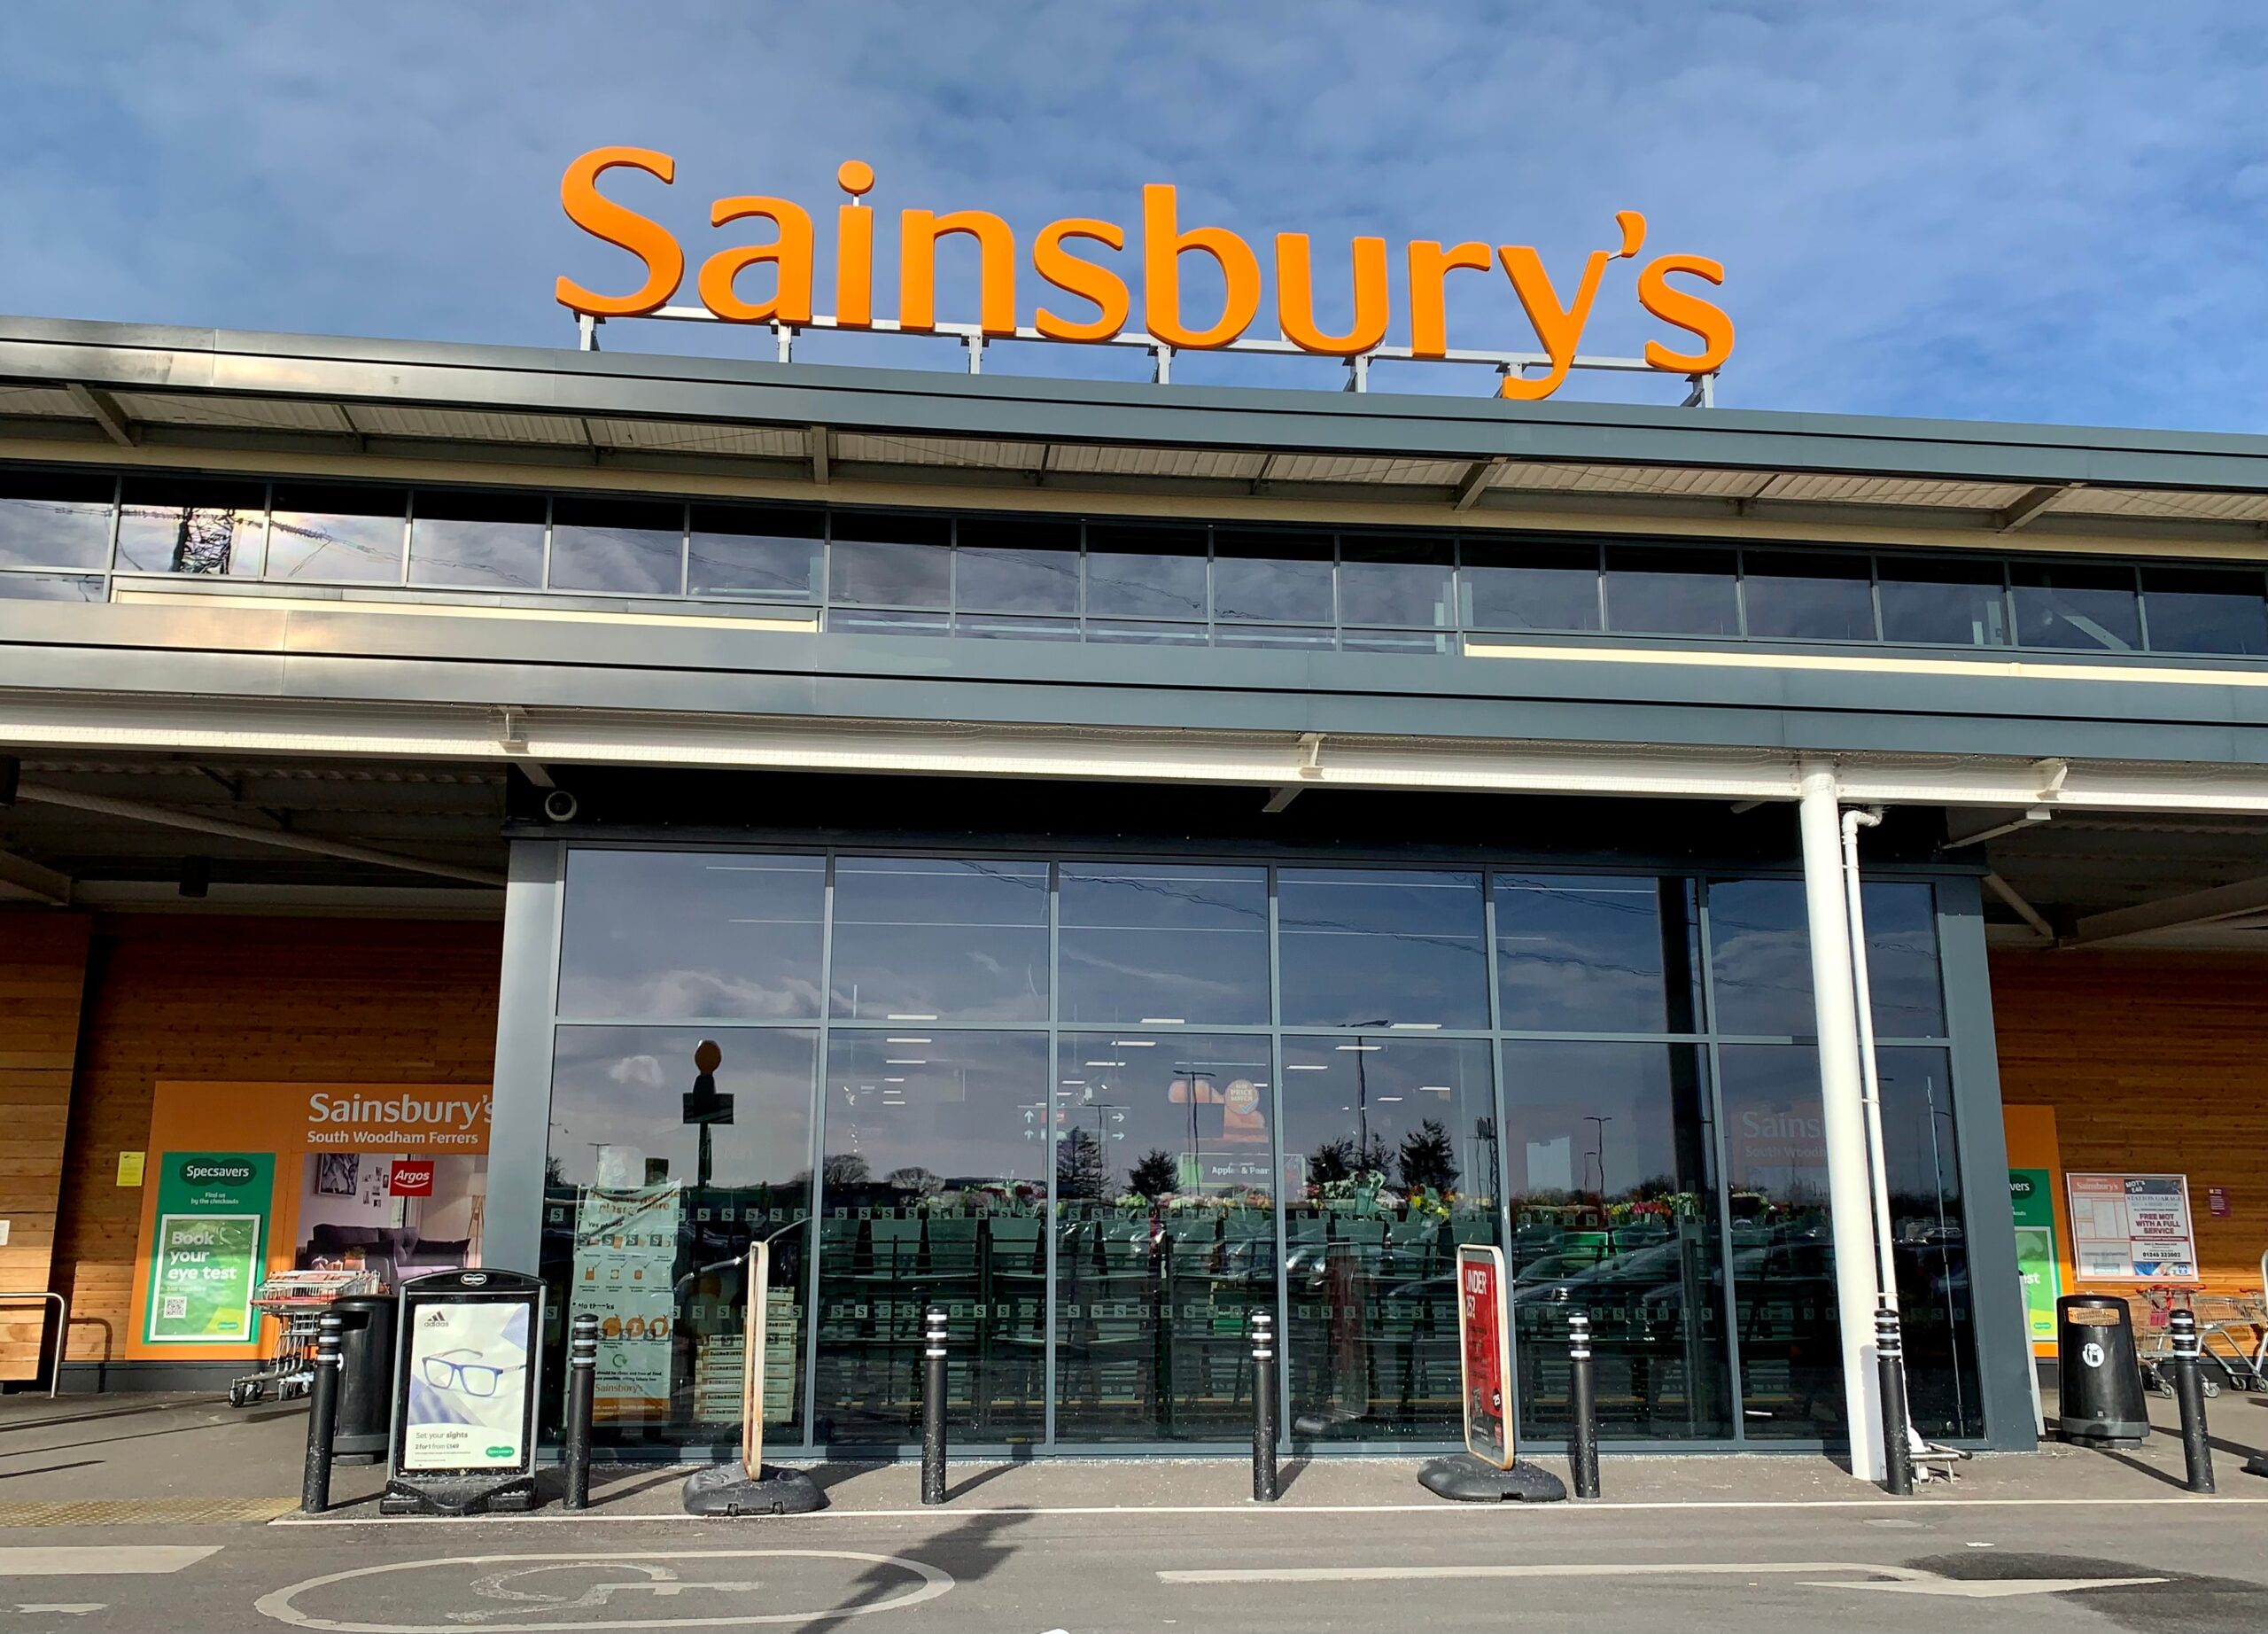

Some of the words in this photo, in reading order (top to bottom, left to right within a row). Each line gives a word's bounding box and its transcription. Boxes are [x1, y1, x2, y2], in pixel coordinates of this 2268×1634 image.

[555, 145, 1734, 401] Sainsbury's
[307, 1130, 349, 1143] South
[353, 1131, 425, 1144] Woodham
[429, 1132, 478, 1144] Ferrers
[186, 1165, 250, 1179] Specsavers
[393, 1170, 430, 1183] Argos
[2076, 1182, 2119, 1192] Sainsbury's
[171, 1231, 214, 1245] Book
[170, 1250, 210, 1265] your
[167, 1267, 198, 1282] eye
[201, 1266, 237, 1280] test
[1464, 1269, 1487, 1295] UNDER
[446, 1431, 468, 1440] sights
